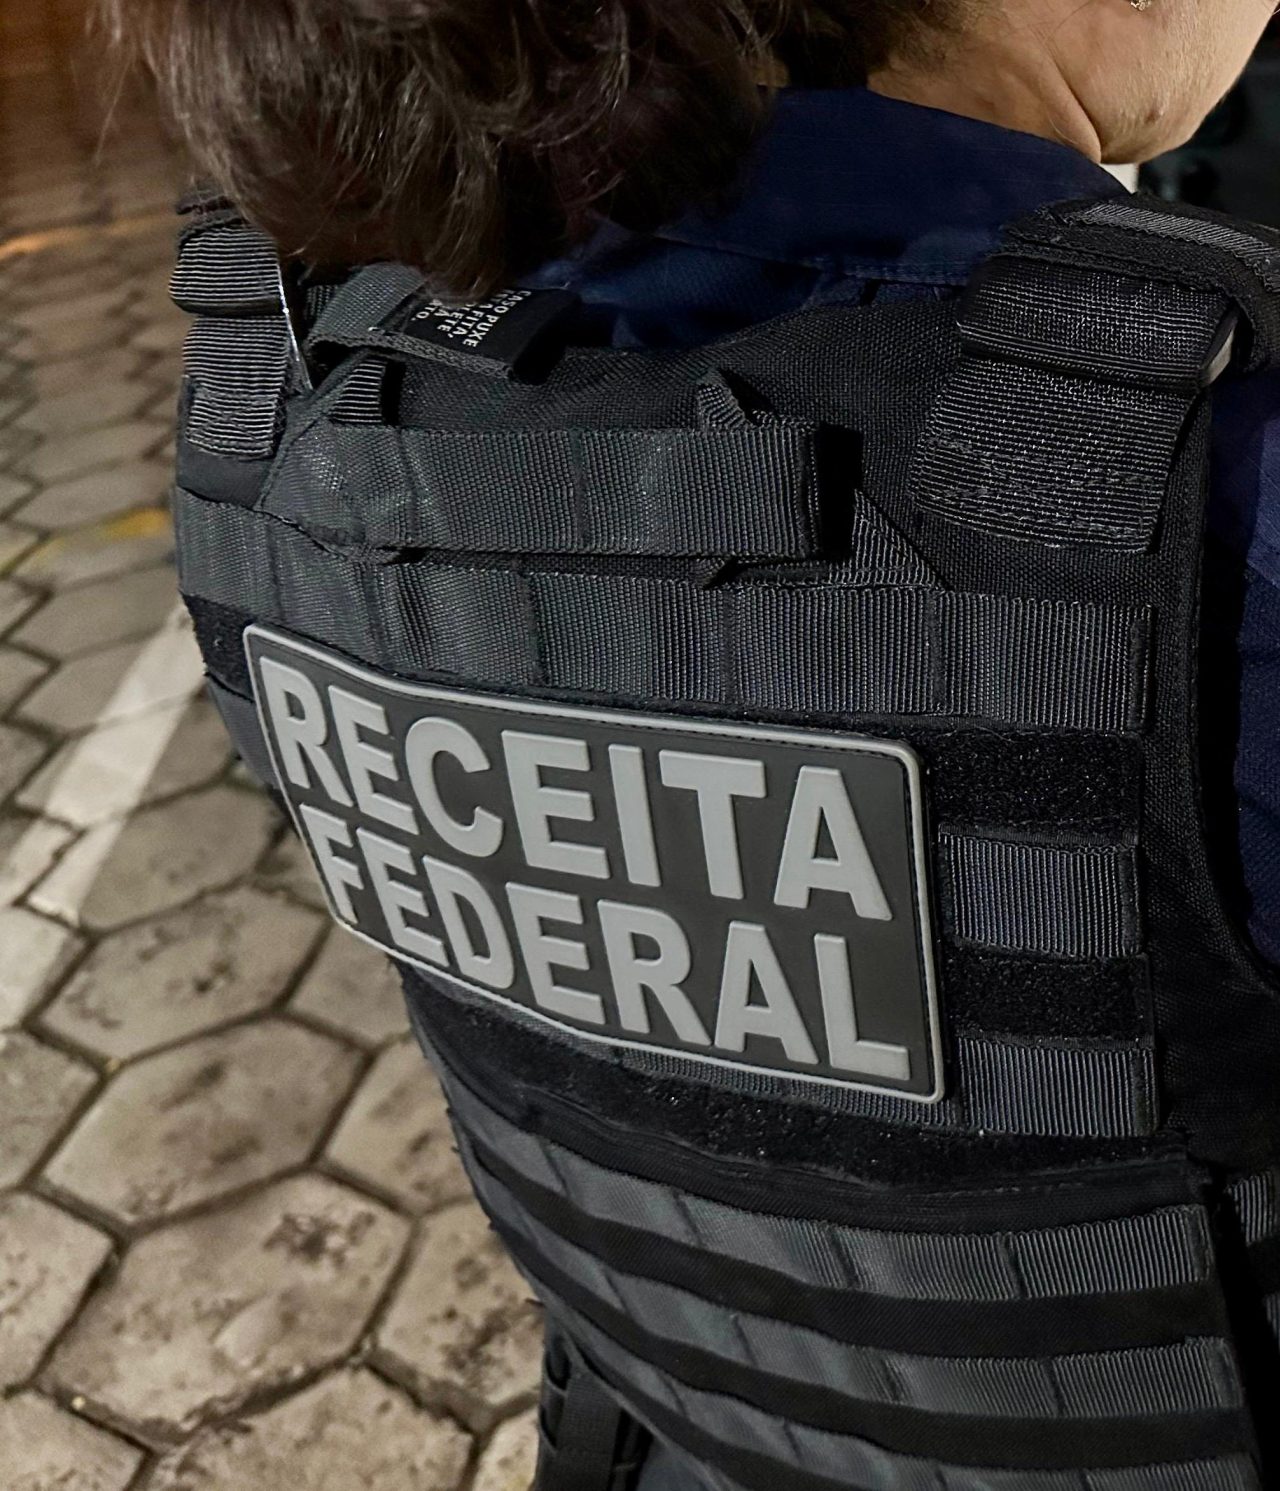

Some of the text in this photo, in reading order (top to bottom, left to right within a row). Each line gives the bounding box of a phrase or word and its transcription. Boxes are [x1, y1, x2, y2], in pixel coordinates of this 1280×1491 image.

[448, 310, 485, 338] FITA,
[463, 290, 532, 347] CASO PUXE
[259, 656, 893, 921] RECEITA
[299, 803, 910, 1081] FEDERAL
